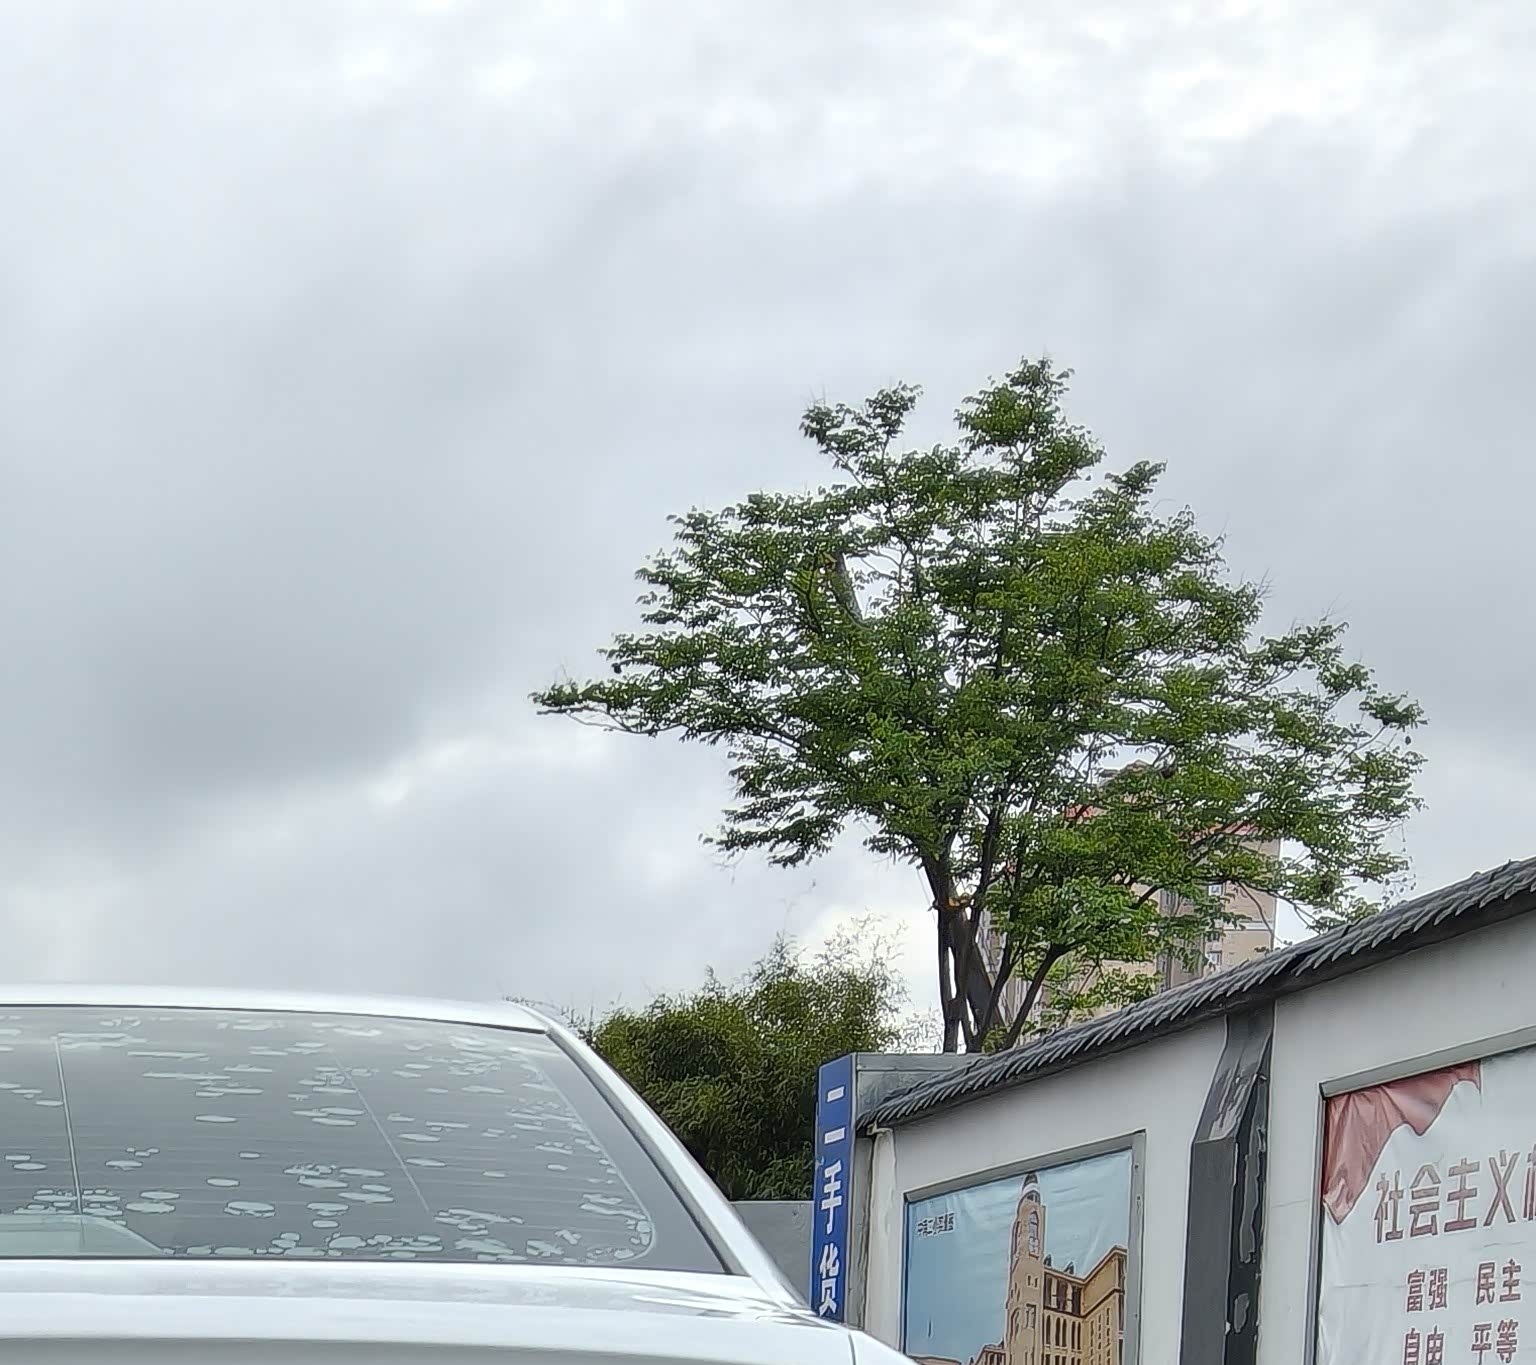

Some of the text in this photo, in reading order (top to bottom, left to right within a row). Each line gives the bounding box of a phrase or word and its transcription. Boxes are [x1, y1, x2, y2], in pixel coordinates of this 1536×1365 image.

[1406, 1259, 1522, 1313] 富强 民主
[1471, 1319, 1519, 1365] 平等
